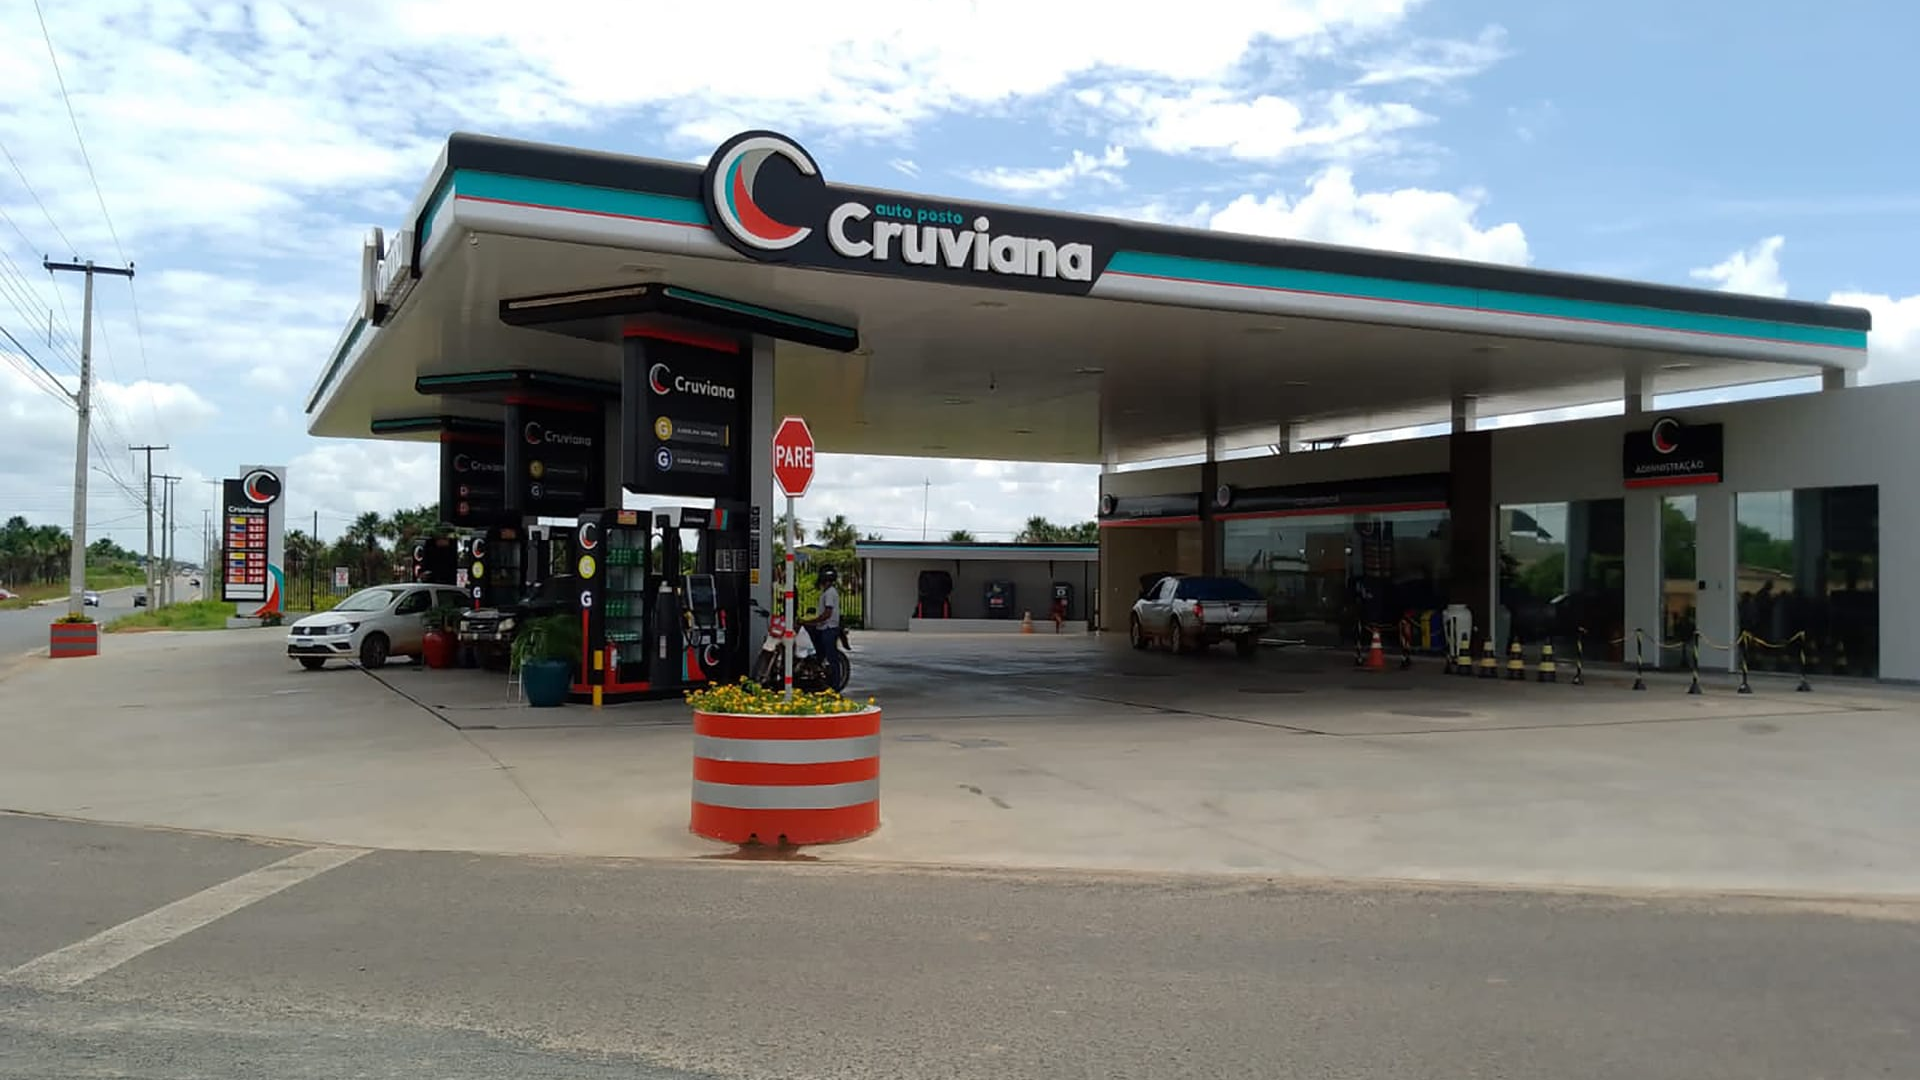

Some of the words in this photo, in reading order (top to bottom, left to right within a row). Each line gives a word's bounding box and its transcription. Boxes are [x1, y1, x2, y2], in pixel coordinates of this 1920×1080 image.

[875, 203, 913, 219] auto
[917, 208, 964, 225] posto
[827, 202, 1093, 282] Cruviana
[675, 376, 735, 399] Cruviana
[544, 430, 592, 446] Cruviana
[657, 452, 669, 467] G
[776, 445, 813, 468] PARE
[580, 590, 593, 607] G
